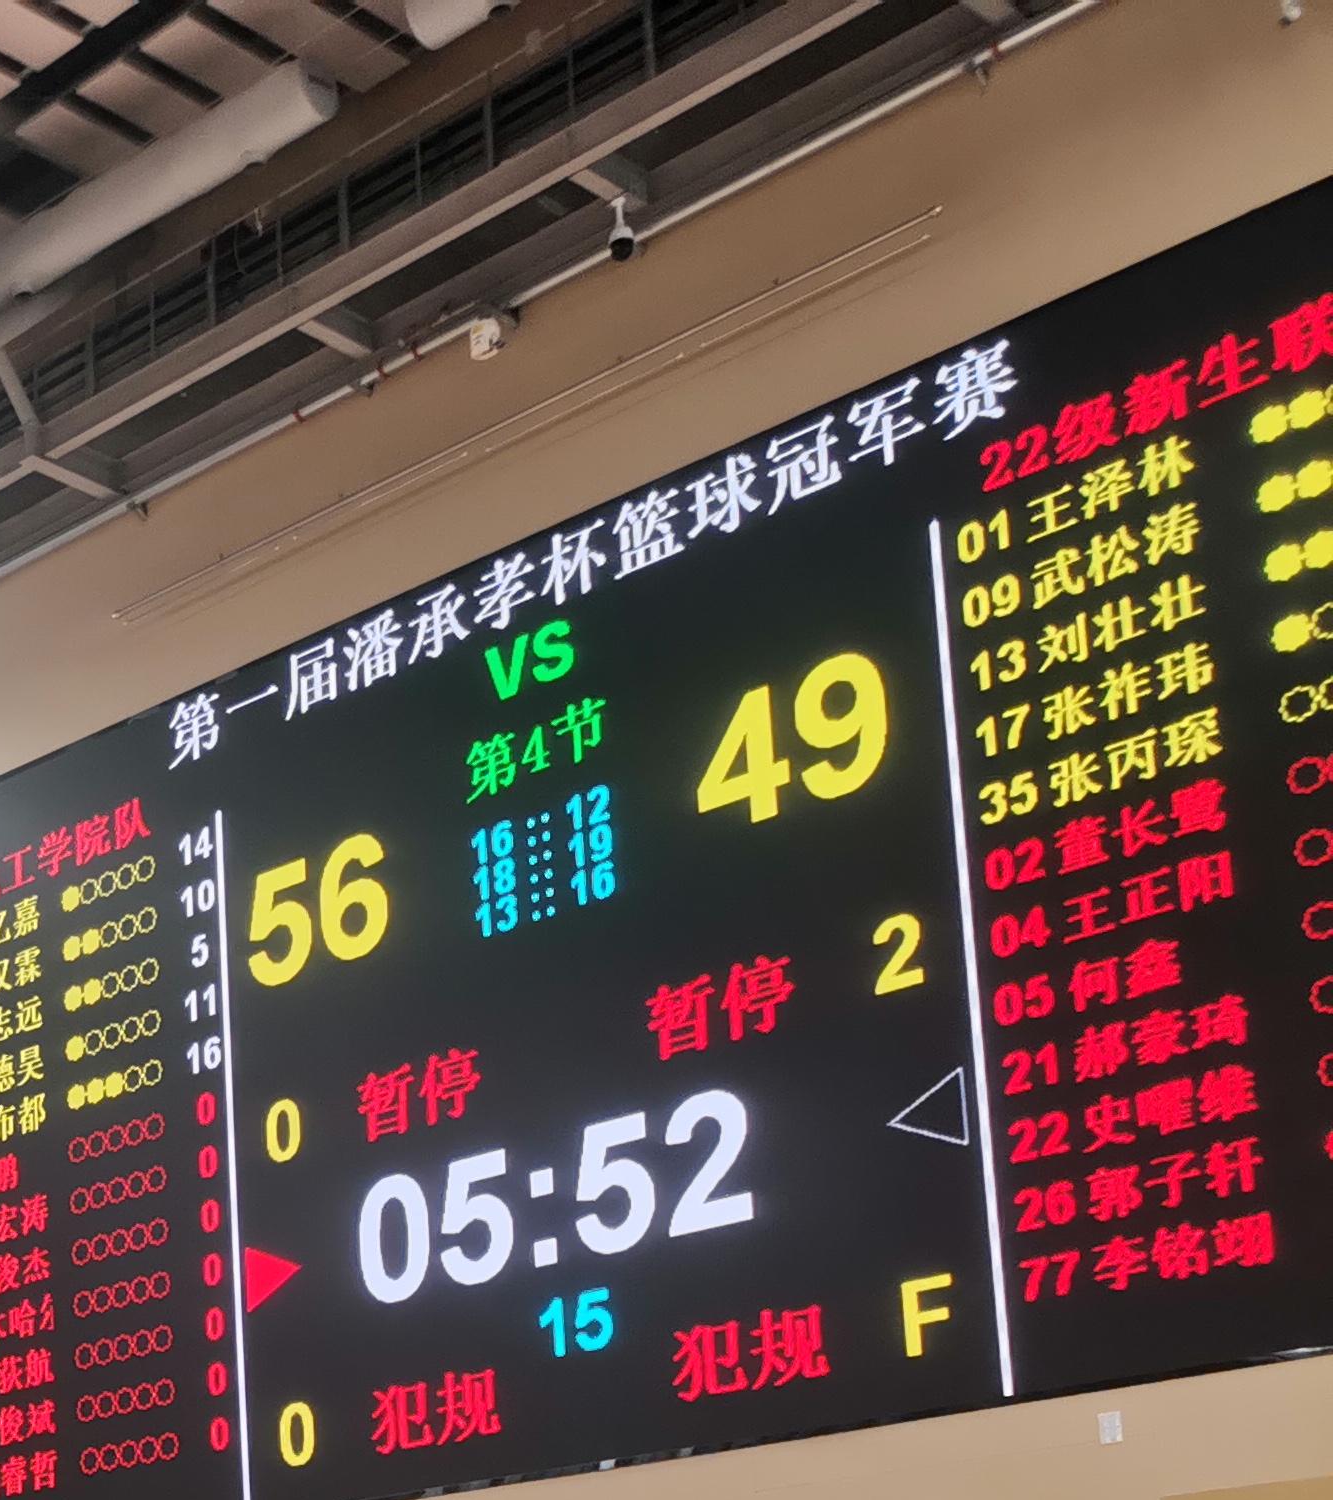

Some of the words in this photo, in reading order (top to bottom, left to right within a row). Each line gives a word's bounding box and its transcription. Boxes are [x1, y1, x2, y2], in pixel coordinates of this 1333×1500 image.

[956, 509, 1012, 564] 01
[1026, 435, 1195, 544] 王泽林
[167, 338, 1019, 772] 第一届潘承孝杯篮球冠军赛
[962, 574, 1021, 628] 09
[1032, 501, 1202, 610] 武松涛
[970, 639, 1027, 691] 13
[1038, 574, 1206, 674] 刘壮壮
[484, 619, 575, 701] VS
[466, 697, 606, 805] 第4节
[697, 653, 888, 823] 49
[975, 703, 1030, 757] 17
[471, 819, 514, 866] 16
[566, 784, 611, 830] 12
[978, 771, 1039, 825] 35
[179, 826, 212, 866] 14
[568, 823, 614, 868] 19
[984, 836, 1046, 891] 02
[181, 879, 215, 917] 10
[248, 833, 389, 987] 56
[475, 893, 518, 938] 13
[570, 859, 616, 906] 16
[990, 905, 1052, 958] 04
[1063, 850, 1233, 944] 王正阳
[190, 934, 208, 968] 5
[184, 983, 217, 1022] 11
[645, 955, 796, 1061] 暂停
[873, 912, 925, 996] 2
[993, 973, 1055, 1026] 05
[187, 1036, 221, 1075] 16
[1001, 1041, 1059, 1096] 21
[197, 1092, 216, 1126] 0
[266, 1097, 302, 1163] 0
[356, 1047, 482, 1142] 暂停
[198, 1145, 218, 1179] 0
[1007, 1111, 1071, 1164] 22
[200, 1199, 221, 1233] 0
[358, 1088, 755, 1304] 05:52
[1012, 1180, 1076, 1232] 26
[202, 1252, 223, 1287] 0
[1018, 1249, 1081, 1302] 77
[205, 1306, 225, 1341] 0
[538, 1286, 614, 1358] 15
[672, 1304, 832, 1401] 犯规
[900, 1272, 952, 1358] F
[206, 1361, 227, 1396] 0
[210, 1416, 230, 1450] 0
[279, 1401, 315, 1466] 0
[370, 1367, 502, 1455] 犯规
